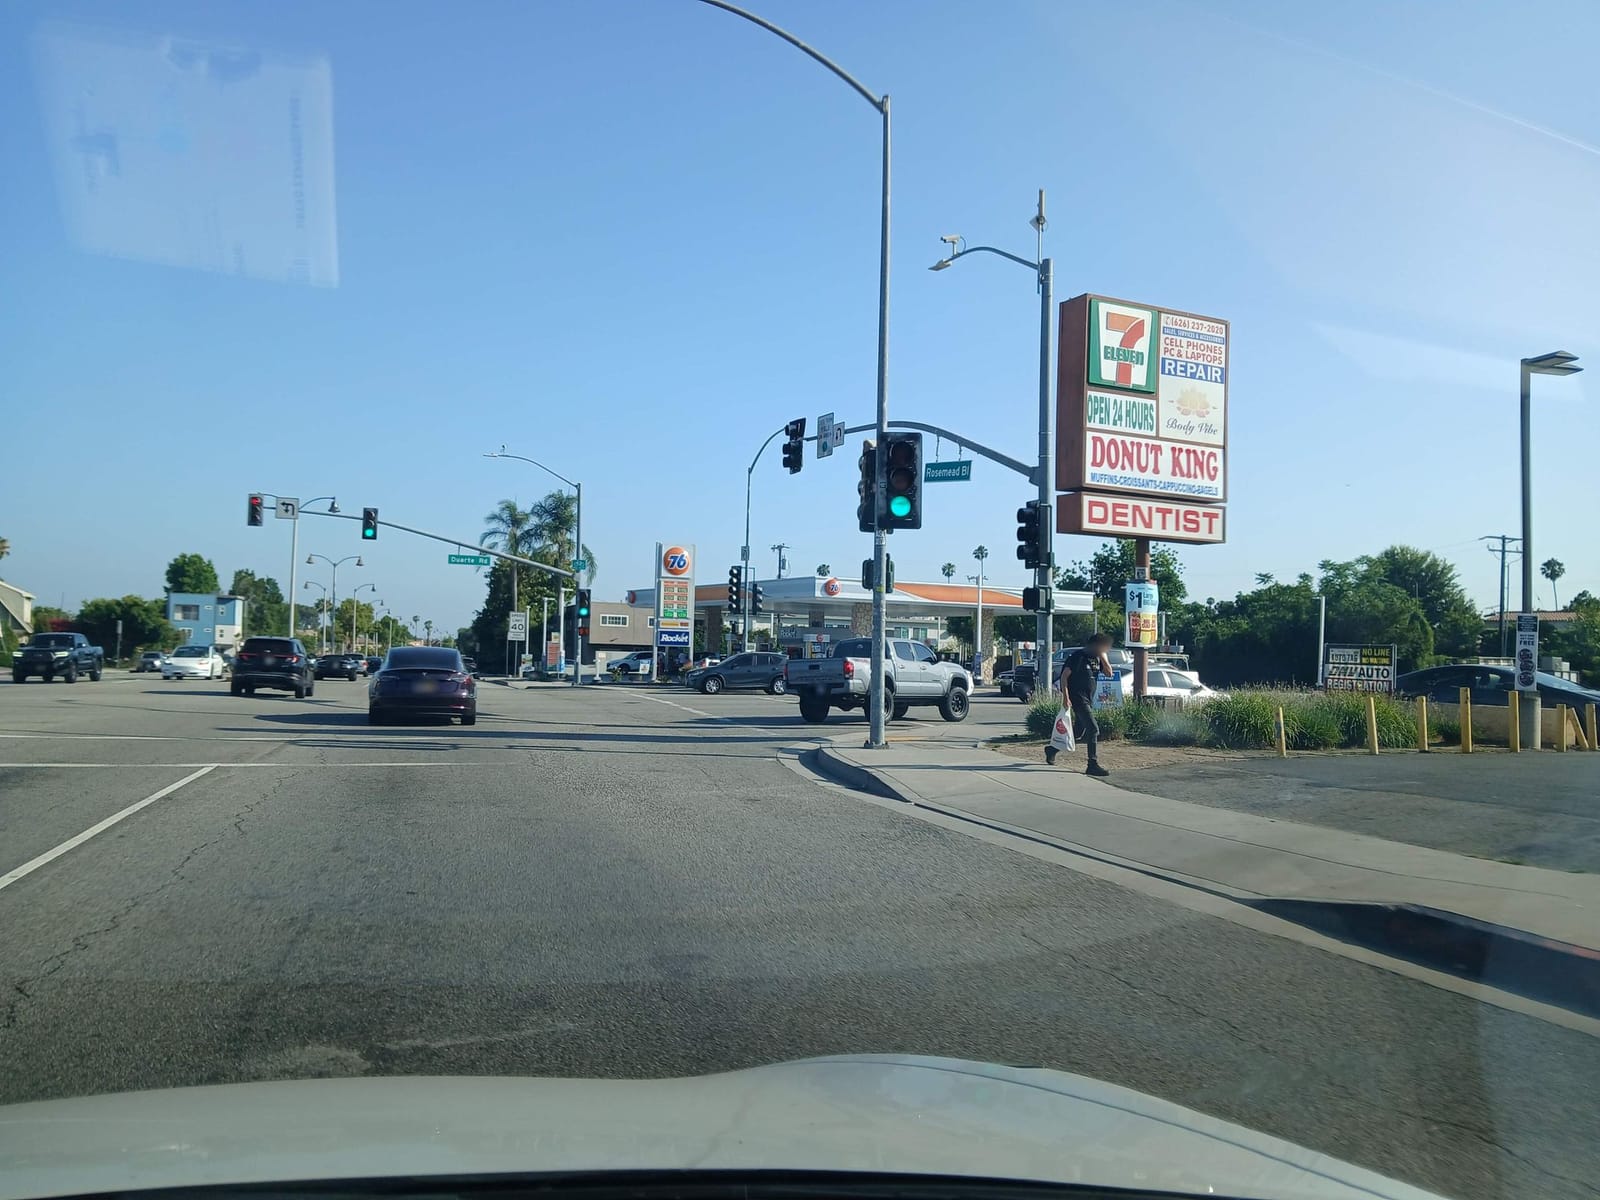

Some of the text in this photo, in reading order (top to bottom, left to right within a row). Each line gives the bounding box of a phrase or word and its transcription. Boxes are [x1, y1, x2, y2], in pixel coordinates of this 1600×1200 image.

[1171, 317, 1224, 335] (626) 237-2020
[1106, 311, 1145, 385] 7
[1163, 337, 1223, 355] CELL PHONES
[1163, 347, 1223, 365] PC & LAPTOPS
[1164, 360, 1222, 383] REPAIR
[1087, 395, 1154, 432] OPEN 24 HOURS
[1166, 417, 1218, 435] Body Vibe
[1091, 435, 1219, 481] DONUT KING
[926, 465, 961, 478] Rosemead
[1088, 500, 1219, 534] DENTIST
[451, 556, 475, 564] Duarte
[669, 554, 687, 569] 76
[830, 584, 839, 592] 76
[1129, 590, 1142, 608] $1
[511, 623, 524, 631] 40
[661, 632, 688, 642] Rocket
[1362, 648, 1373, 656] NO
[1374, 648, 1390, 656] LINE
[1359, 667, 1390, 678] AUTO
